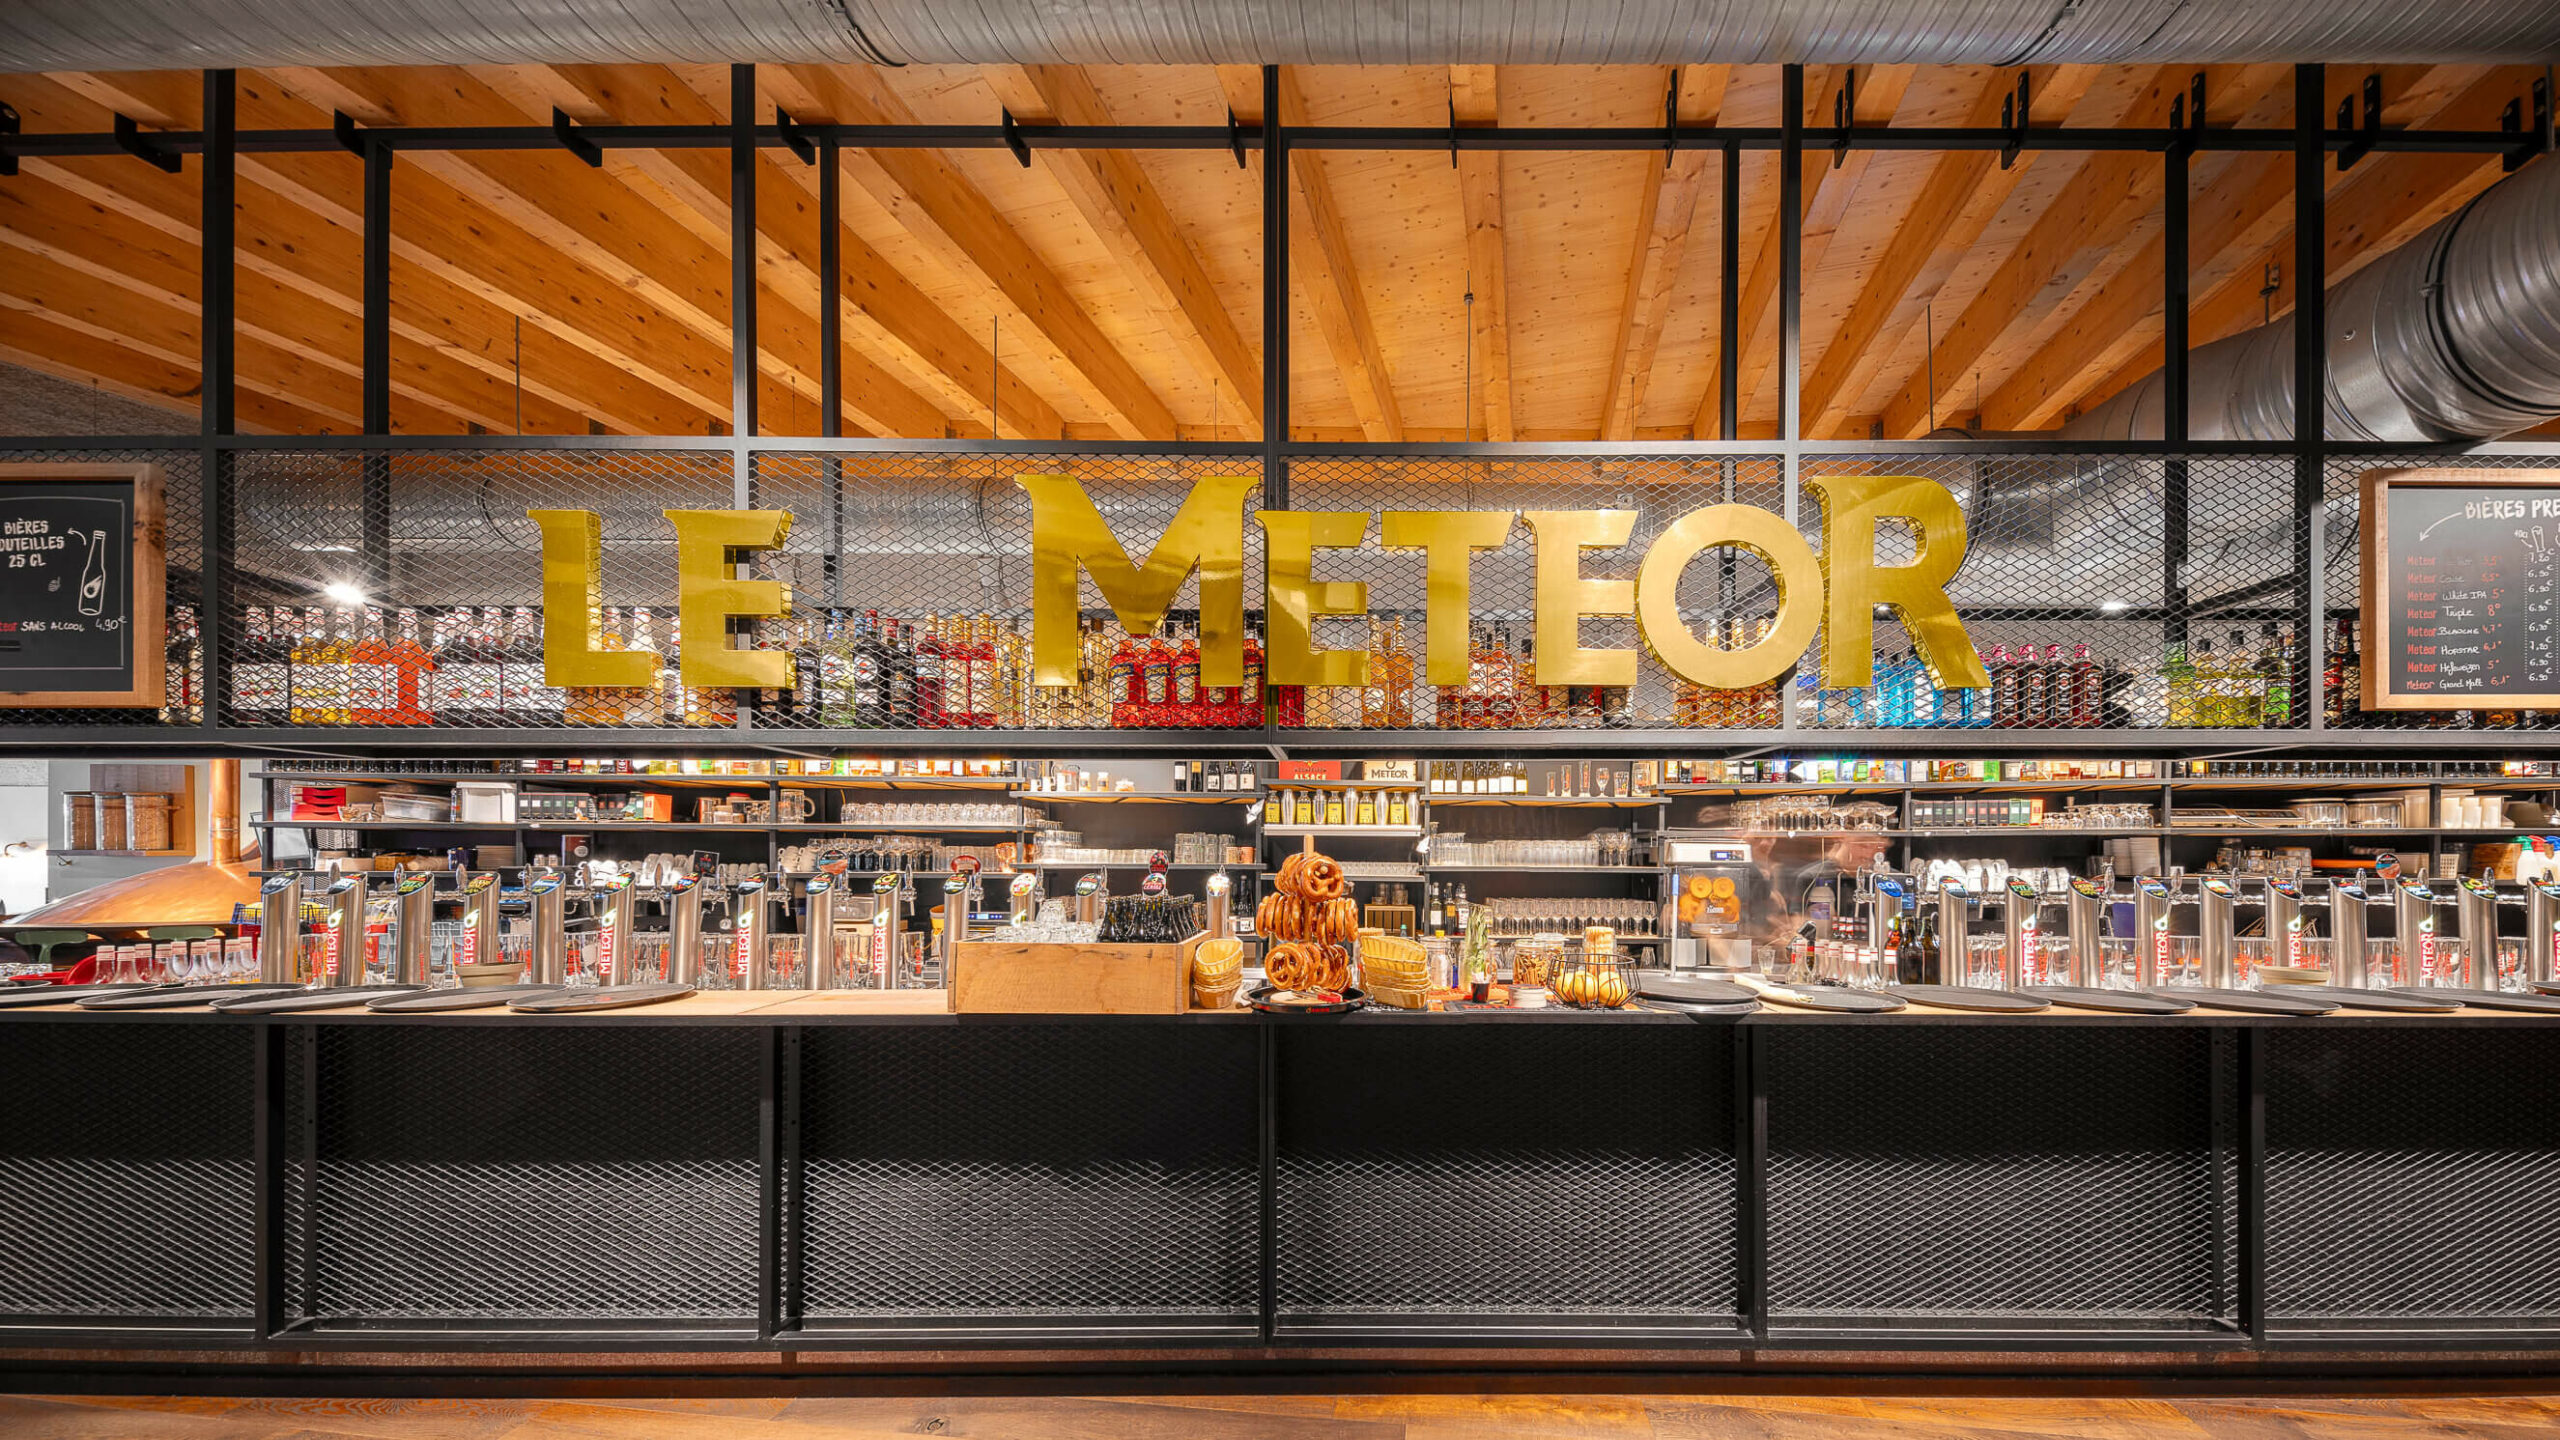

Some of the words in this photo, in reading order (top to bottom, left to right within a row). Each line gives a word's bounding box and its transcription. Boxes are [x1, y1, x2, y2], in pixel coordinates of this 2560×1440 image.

[4, 518, 49, 534] BIÈRES
[2465, 496, 2526, 519] BIÈRES
[2532, 498, 2560, 518] PRE
[9, 554, 26, 568] 25
[527, 510, 793, 688] LE
[1014, 474, 1991, 689] METEOR
[20, 620, 46, 632] SANS
[50, 621, 85, 632] ALCOOL
[1371, 769, 1408, 778] METEOR
[326, 927, 340, 975] METEOR
[464, 927, 477, 964] ETEOR
[600, 926, 614, 975] METEOR
[738, 926, 751, 975] METEOR
[874, 926, 887, 975] METEOR
[2022, 931, 2036, 978] METEOR
[2155, 931, 2168, 978] METEOR
[2289, 931, 2301, 967] ETEOR
[2420, 932, 2434, 979] METEOR
